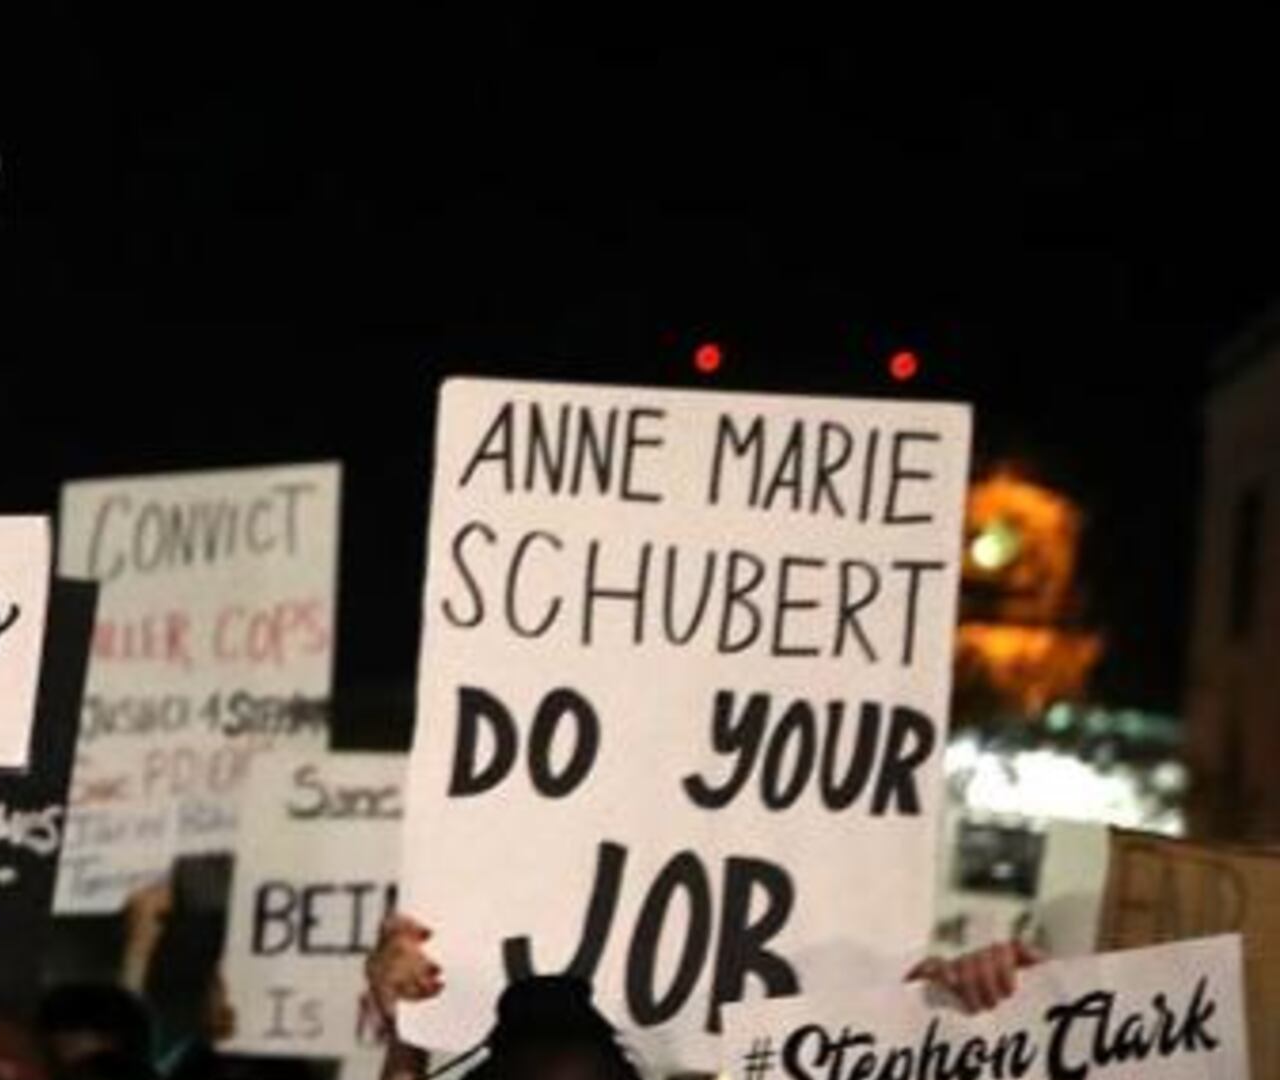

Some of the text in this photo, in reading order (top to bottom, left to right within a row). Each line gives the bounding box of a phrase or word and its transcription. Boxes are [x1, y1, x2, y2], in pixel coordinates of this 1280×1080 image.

[459, 401, 942, 526] ANNE MARIE
[87, 480, 318, 580] CONVICT
[212, 598, 330, 665] COPS
[441, 520, 947, 668] SCHUBERT
[447, 685, 937, 817] DO YOUR
[250, 878, 398, 957] BEI
